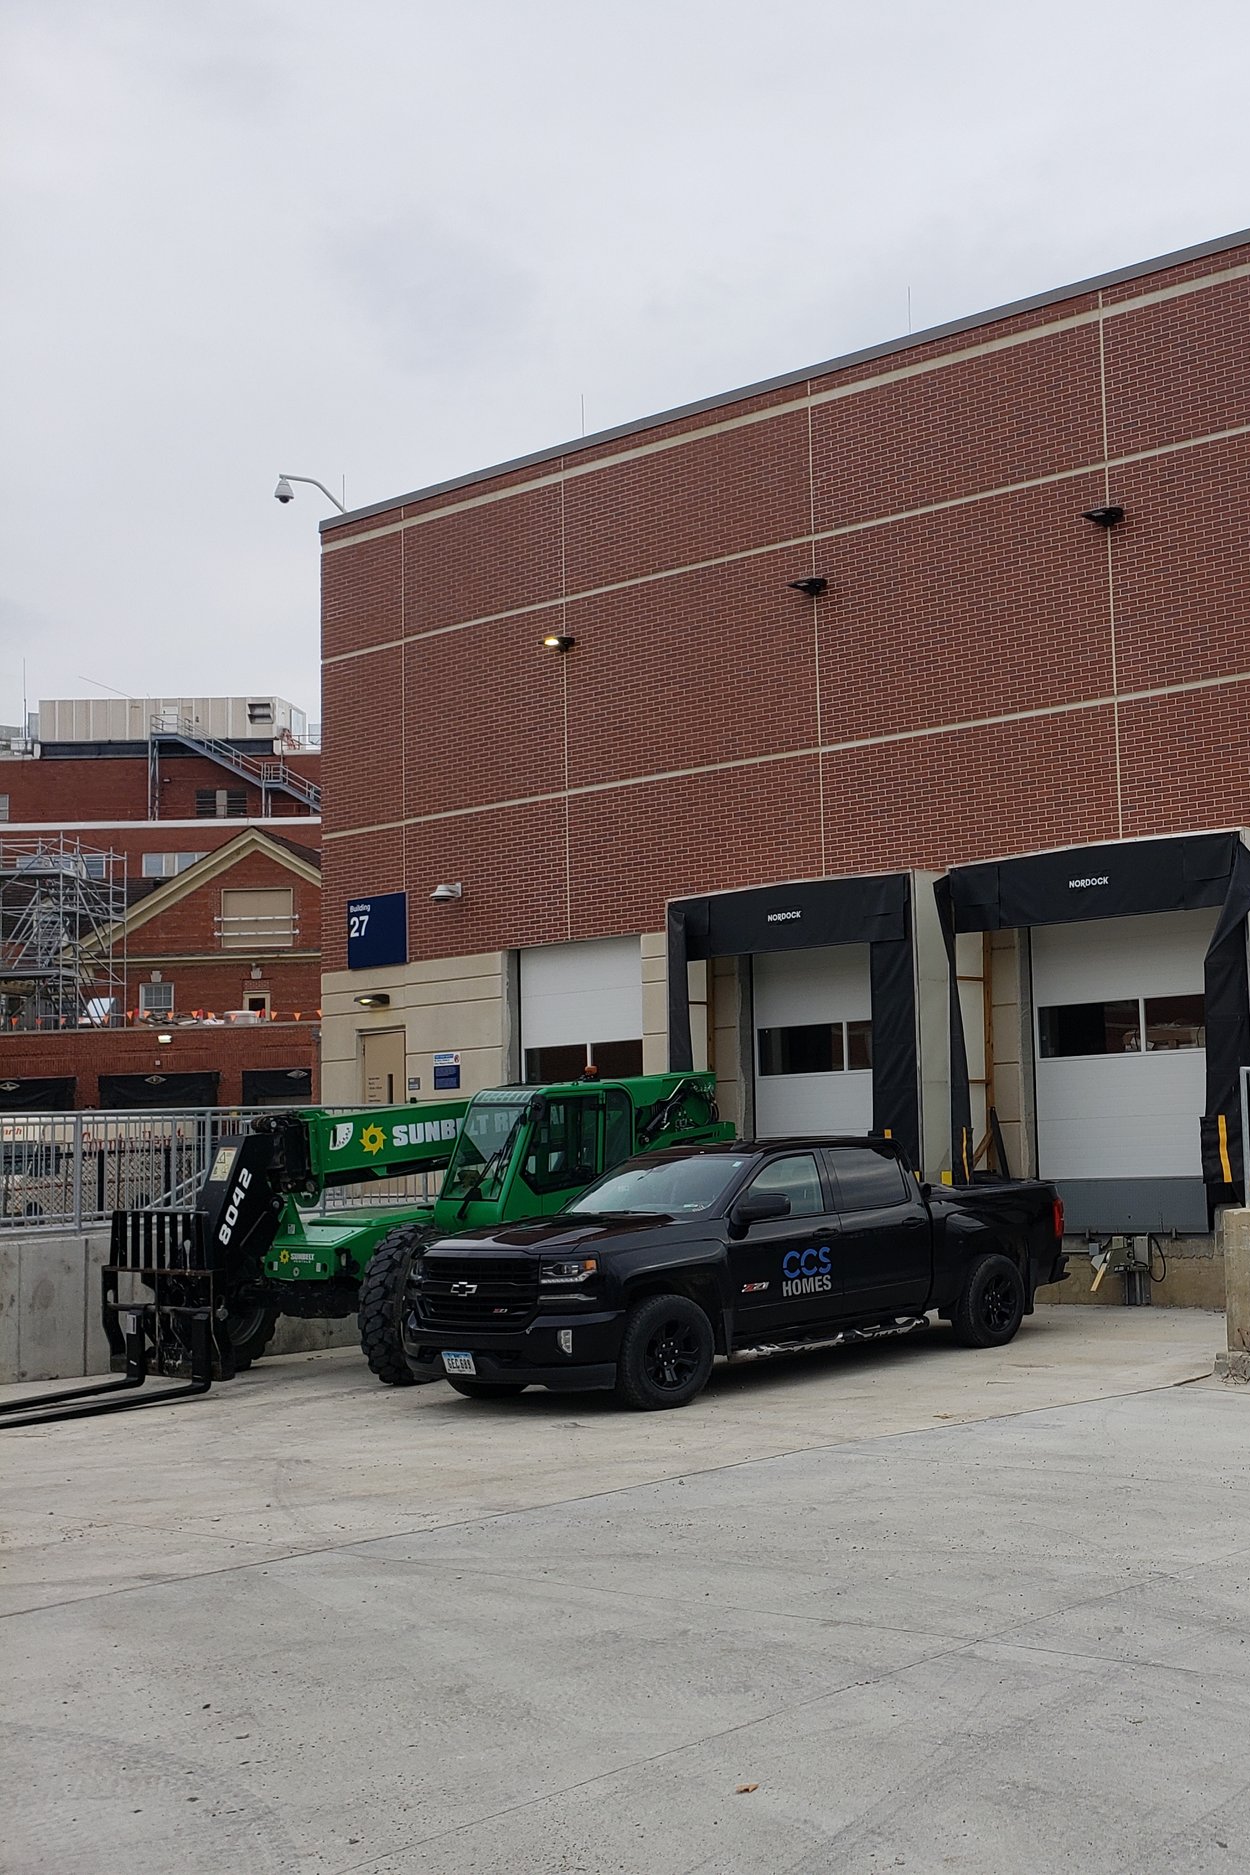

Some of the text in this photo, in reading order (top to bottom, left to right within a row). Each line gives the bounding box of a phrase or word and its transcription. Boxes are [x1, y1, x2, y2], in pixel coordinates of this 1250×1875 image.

[1069, 876, 1109, 889] NORDOCK
[350, 904, 371, 913] Building
[767, 910, 802, 922] NORDOCK
[350, 915, 369, 938] 27
[219, 1167, 253, 1246] 8042
[782, 1246, 832, 1279] CCS
[782, 1274, 832, 1297] HOMES
